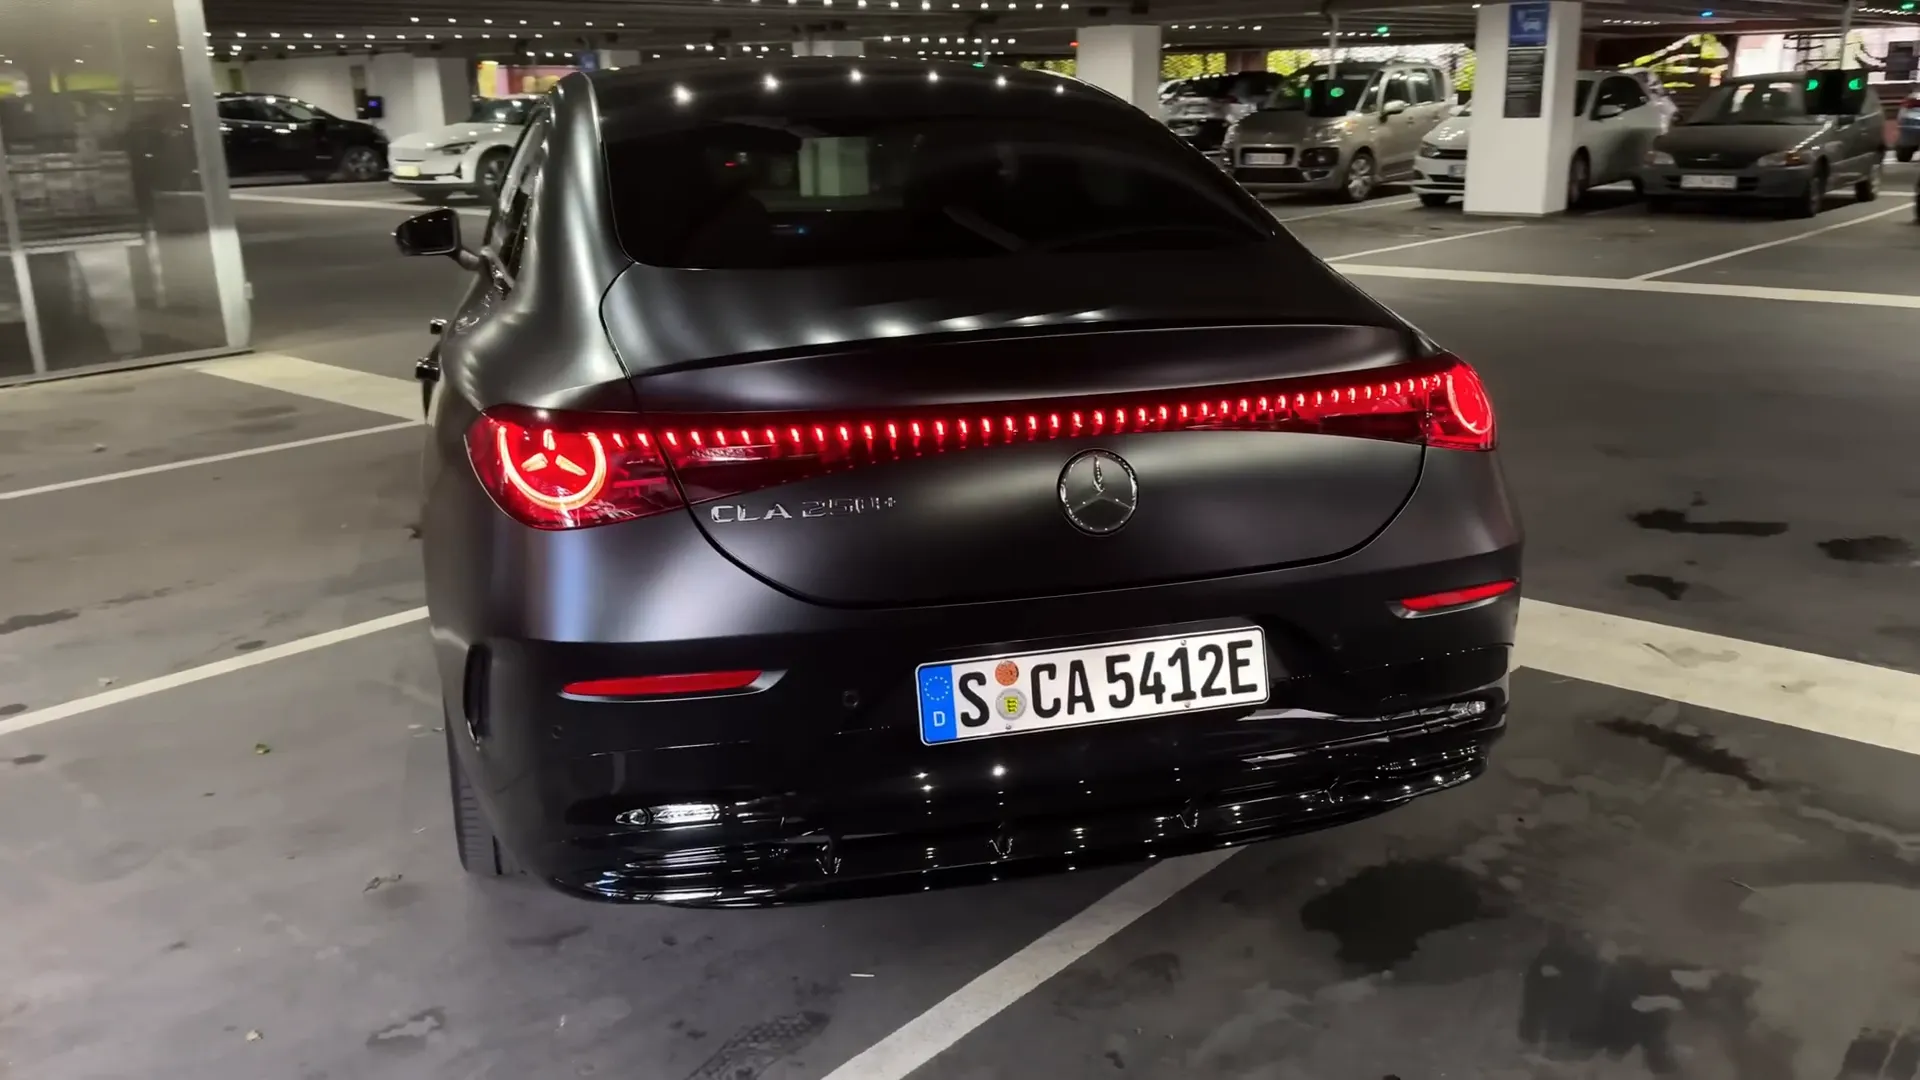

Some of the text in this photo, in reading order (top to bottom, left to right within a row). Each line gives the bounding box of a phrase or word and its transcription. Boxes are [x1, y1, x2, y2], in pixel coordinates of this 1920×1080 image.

[710, 497, 896, 523] CLA 250+
[958, 639, 1258, 728] S CA 5412E
[932, 710, 946, 727] D
